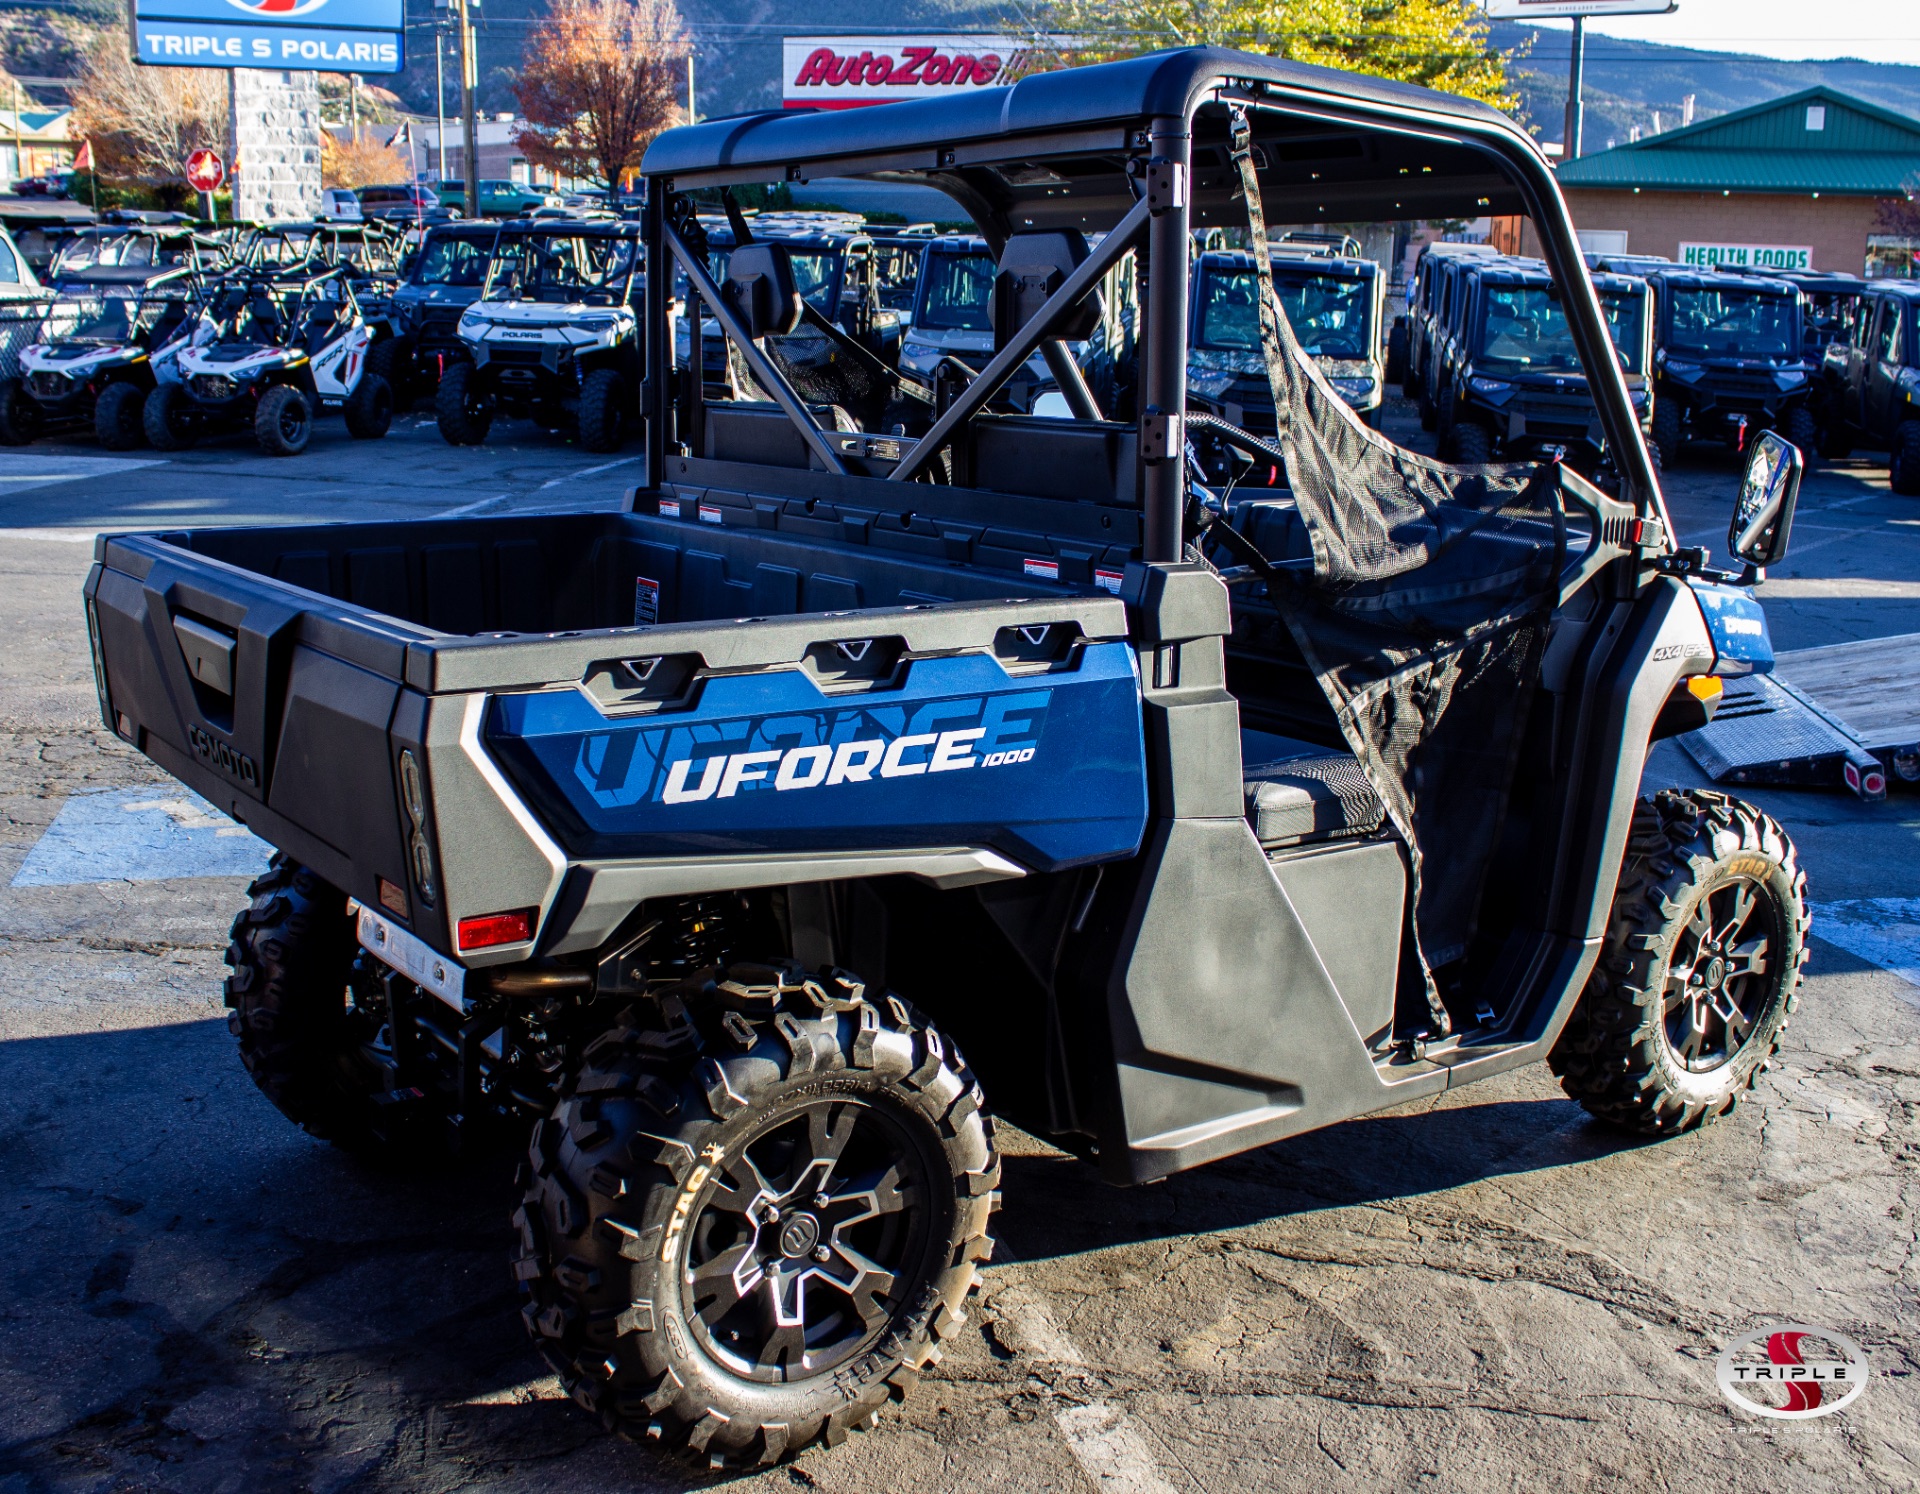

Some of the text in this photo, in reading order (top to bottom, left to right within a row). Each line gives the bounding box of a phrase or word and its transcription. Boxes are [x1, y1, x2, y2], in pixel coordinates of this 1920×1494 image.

[145, 34, 398, 63] TRIPLE S POLARIS
[794, 46, 1001, 86] AutoZone
[502, 331, 543, 339] POLARIS
[1653, 645, 1683, 661] 4X4
[187, 723, 260, 788] CFMOTO
[662, 727, 1035, 805] UFORCE 1000
[662, 1164, 711, 1263] STAG
